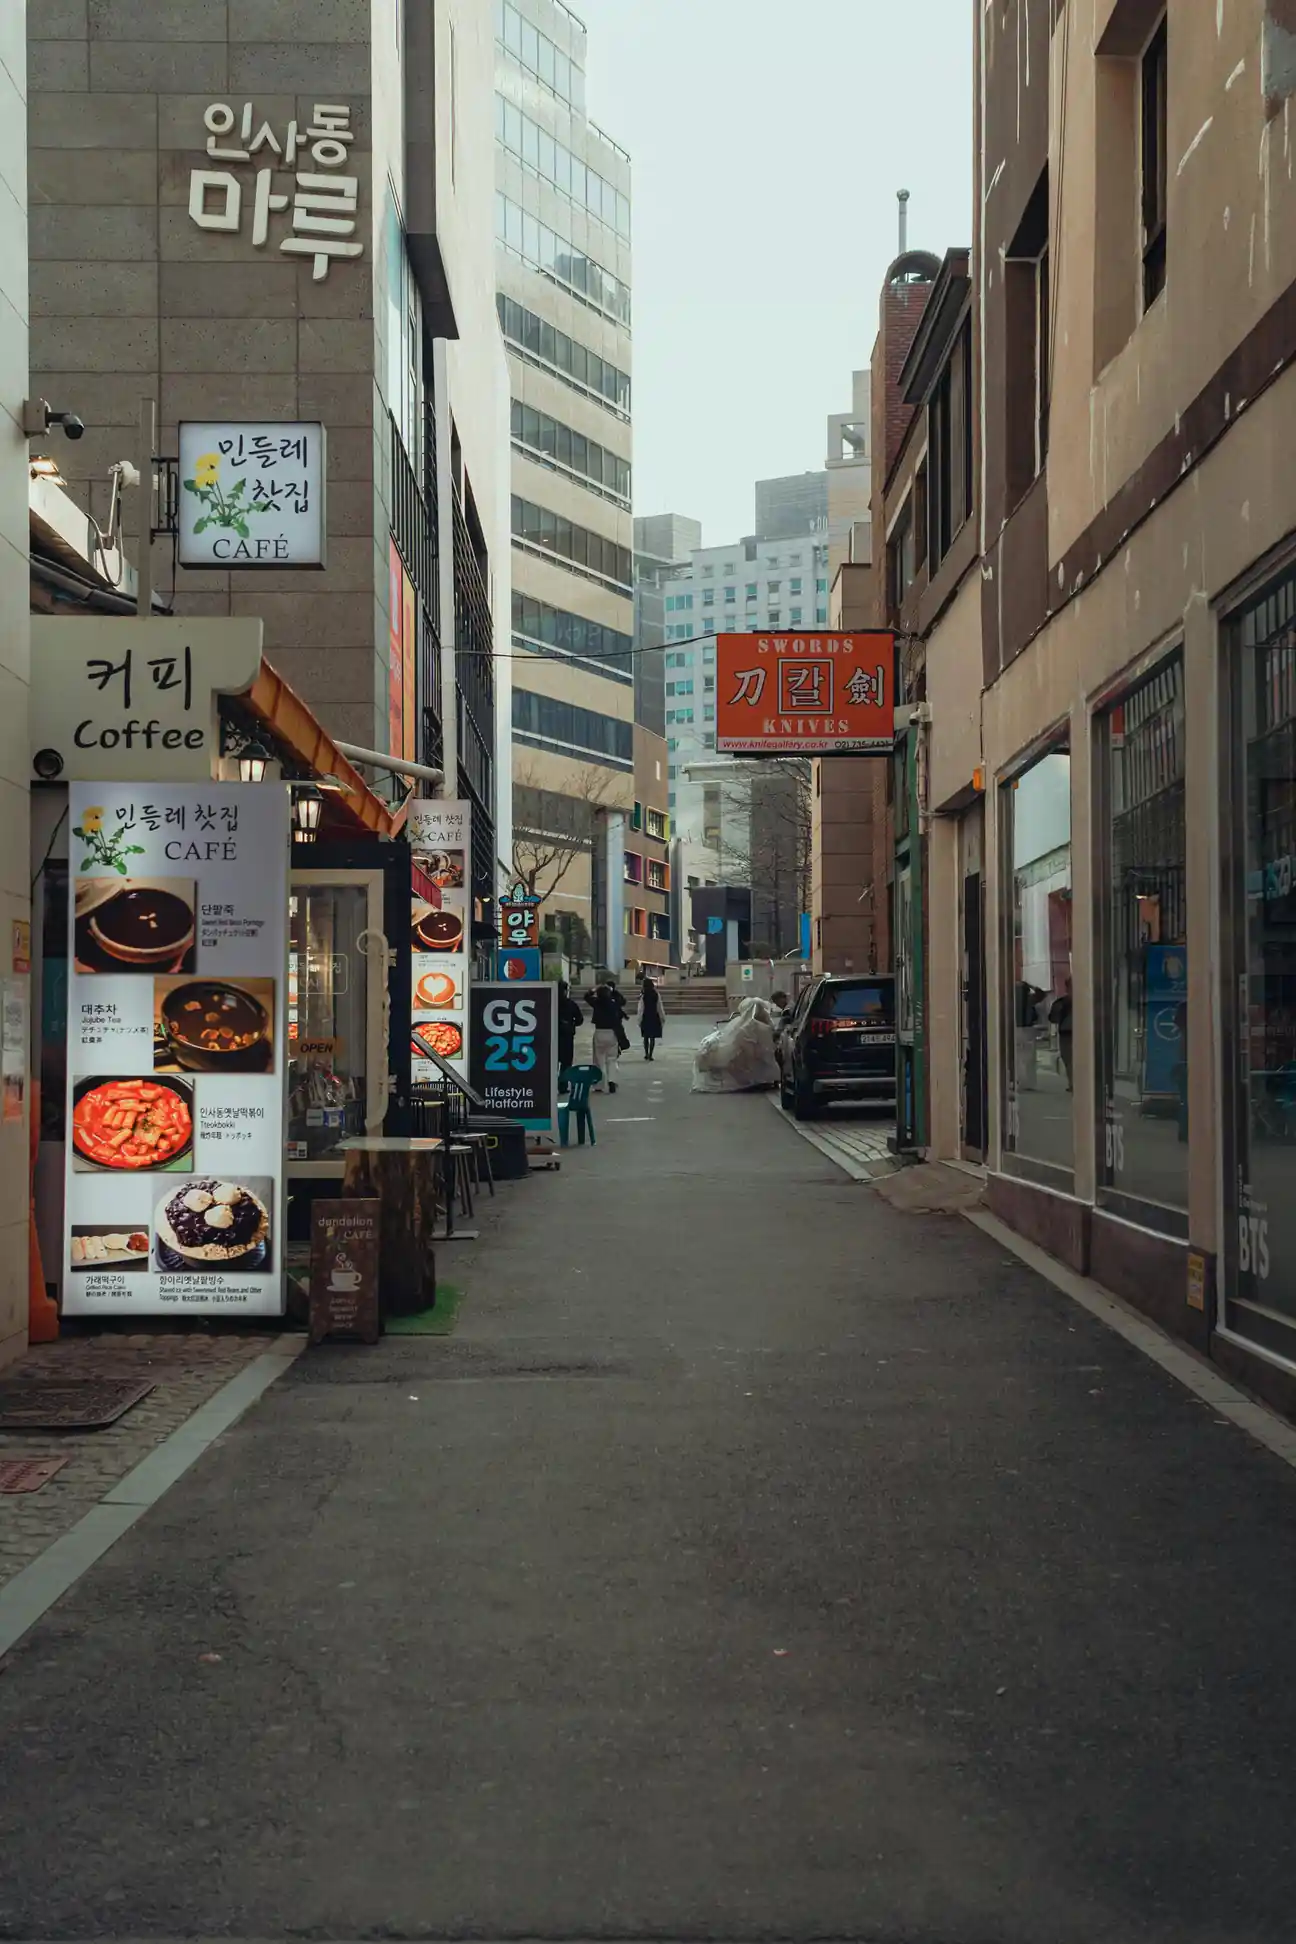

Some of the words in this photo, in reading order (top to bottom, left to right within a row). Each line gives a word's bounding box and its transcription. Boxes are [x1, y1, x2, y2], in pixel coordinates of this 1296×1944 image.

[203, 102, 354, 168] 인사동
[188, 168, 364, 282] 마루
[218, 434, 308, 469] 민들레
[252, 479, 309, 514] 찻집
[212, 533, 290, 560] CAFÉ
[757, 638, 854, 654] SWORDS
[86, 646, 192, 711] 커피
[727, 666, 767, 707] 刀
[787, 665, 826, 708] 칼
[73, 719, 205, 750] Coffee
[763, 718, 850, 734] KNIVES
[723, 739, 828, 750] www.knifegallery.co.kr
[115, 803, 186, 832] 민들레
[194, 803, 239, 833] 찻집
[445, 813, 463, 826] 찻집
[164, 836, 238, 861] CAFÉ
[427, 828, 463, 842] CAFÉ
[81, 1016, 106, 1025] Jujube
[482, 999, 538, 1034] GS
[300, 1043, 333, 1053] OPEN
[484, 1035, 538, 1071] 25
[484, 1086, 534, 1100] Lifestyle
[484, 1098, 534, 1109] Platform
[200, 1120, 236, 1129] Tteokbokki
[1105, 1123, 1124, 1172] BTS
[318, 1213, 373, 1227] dandelion
[1238, 1215, 1270, 1280] BTS
